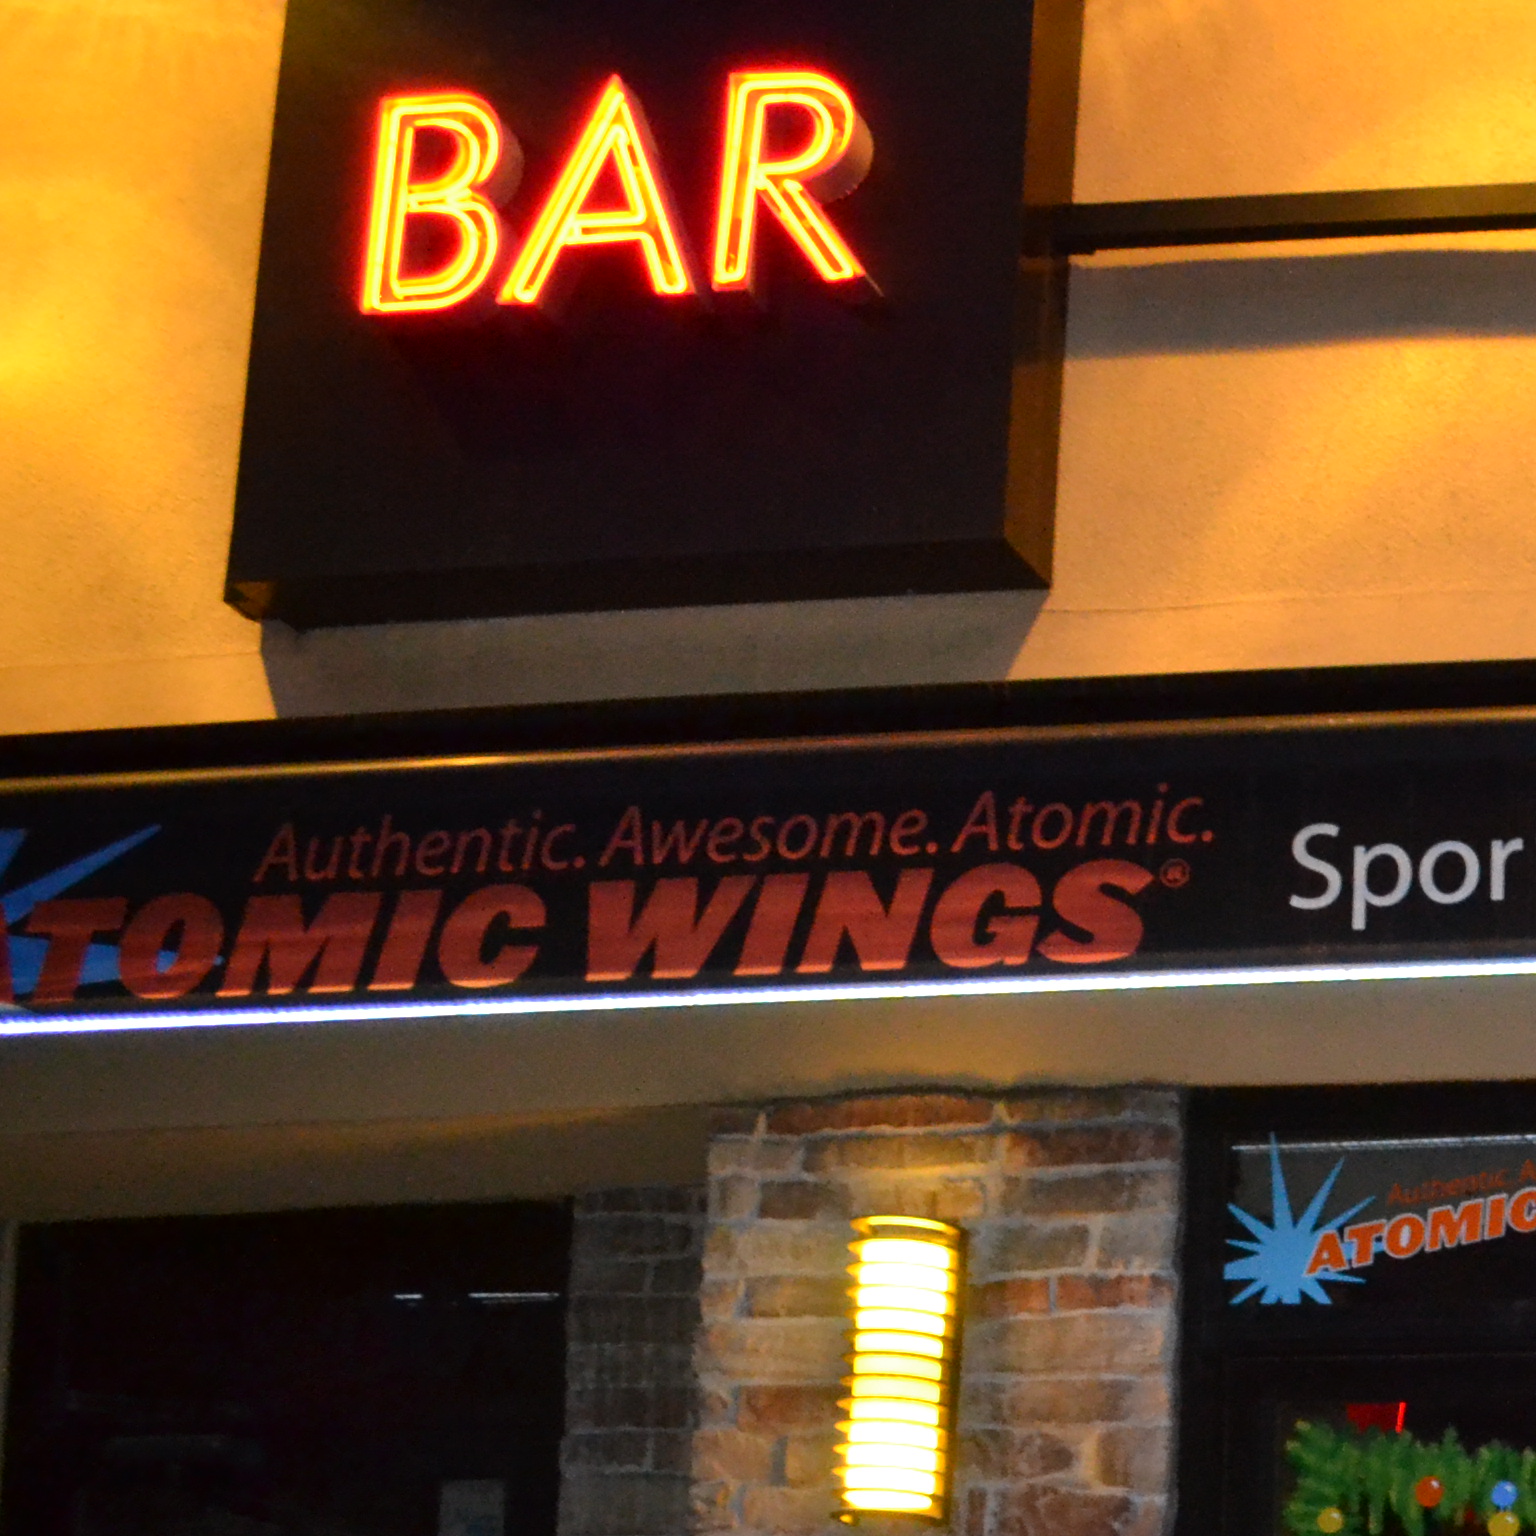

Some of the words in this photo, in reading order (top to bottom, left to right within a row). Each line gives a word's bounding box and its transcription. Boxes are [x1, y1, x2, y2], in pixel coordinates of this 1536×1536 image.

[361, 70, 868, 315] BAR
[252, 810, 586, 882] Authentic.
[599, 805, 940, 868] Awesome.
[951, 782, 1215, 854] Atomic.
[0, 884, 548, 1003] TOMIC
